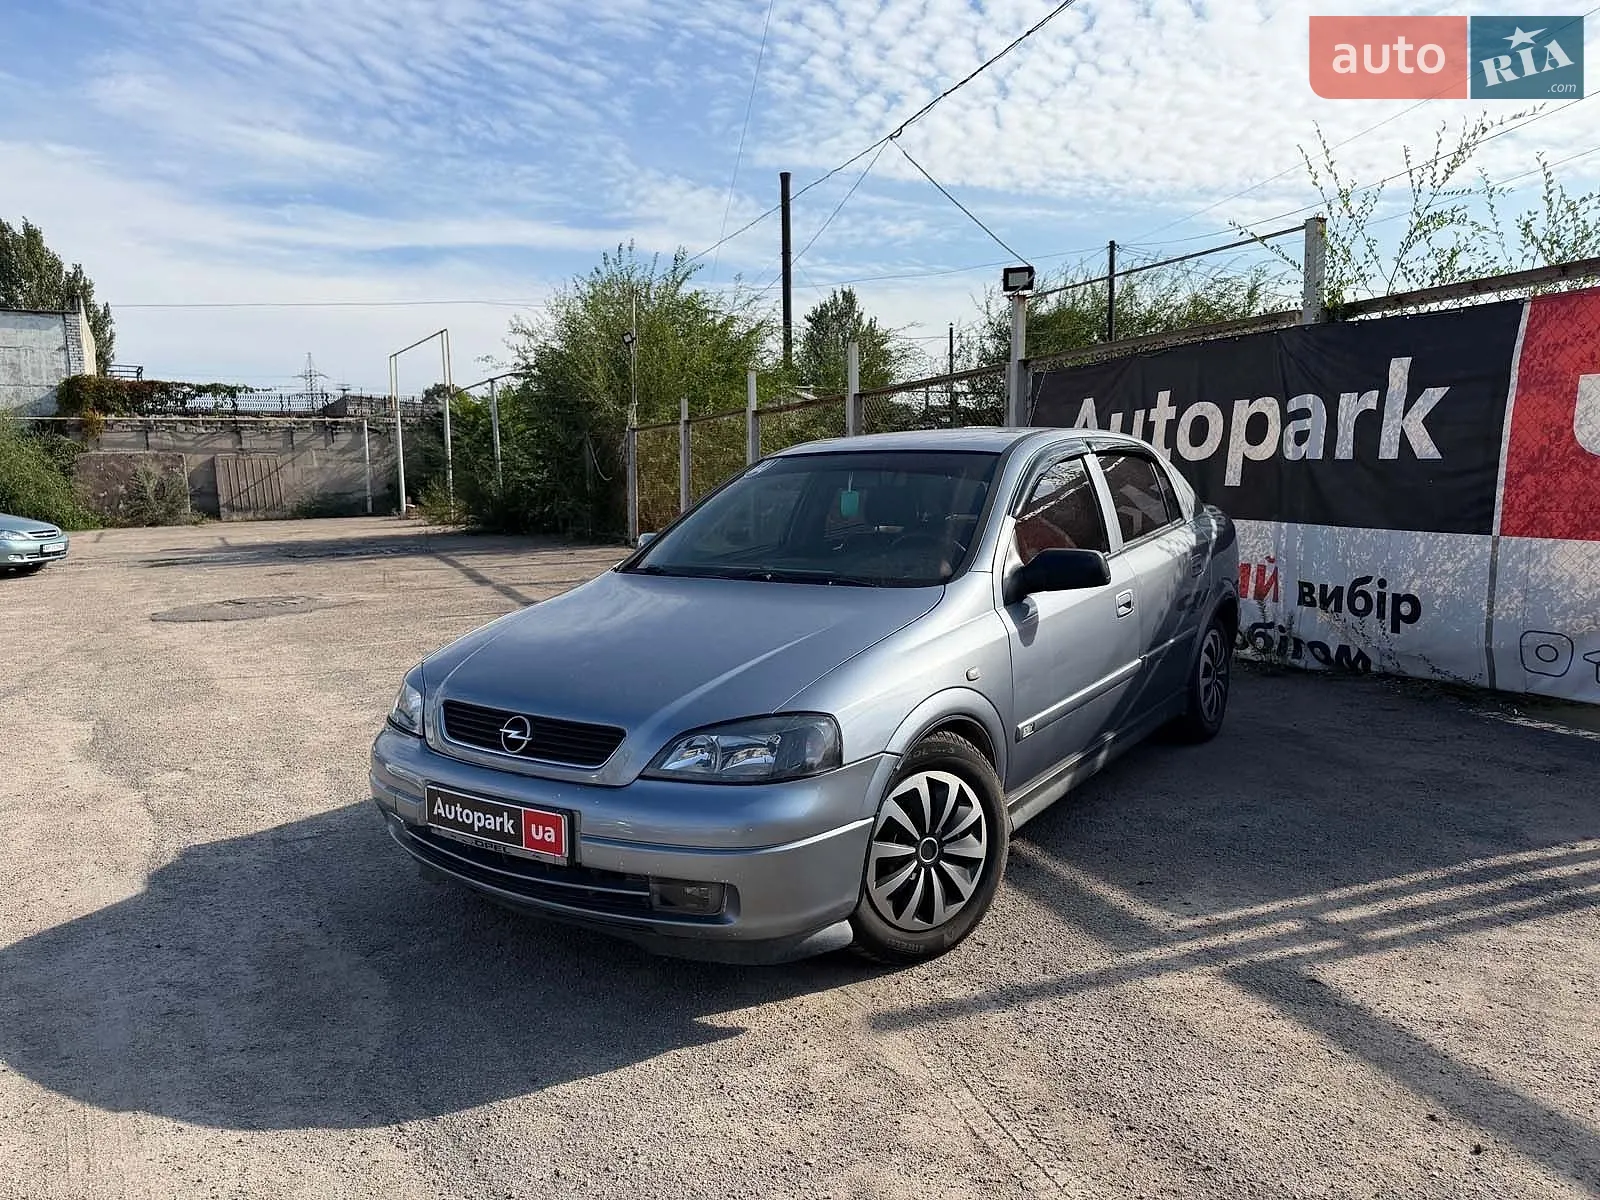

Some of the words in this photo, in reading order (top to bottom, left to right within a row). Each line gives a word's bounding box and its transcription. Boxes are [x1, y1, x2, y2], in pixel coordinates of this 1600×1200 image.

[1297, 575, 1422, 634] вибір
[433, 797, 515, 834] Autopark
[531, 823, 556, 843] ua
